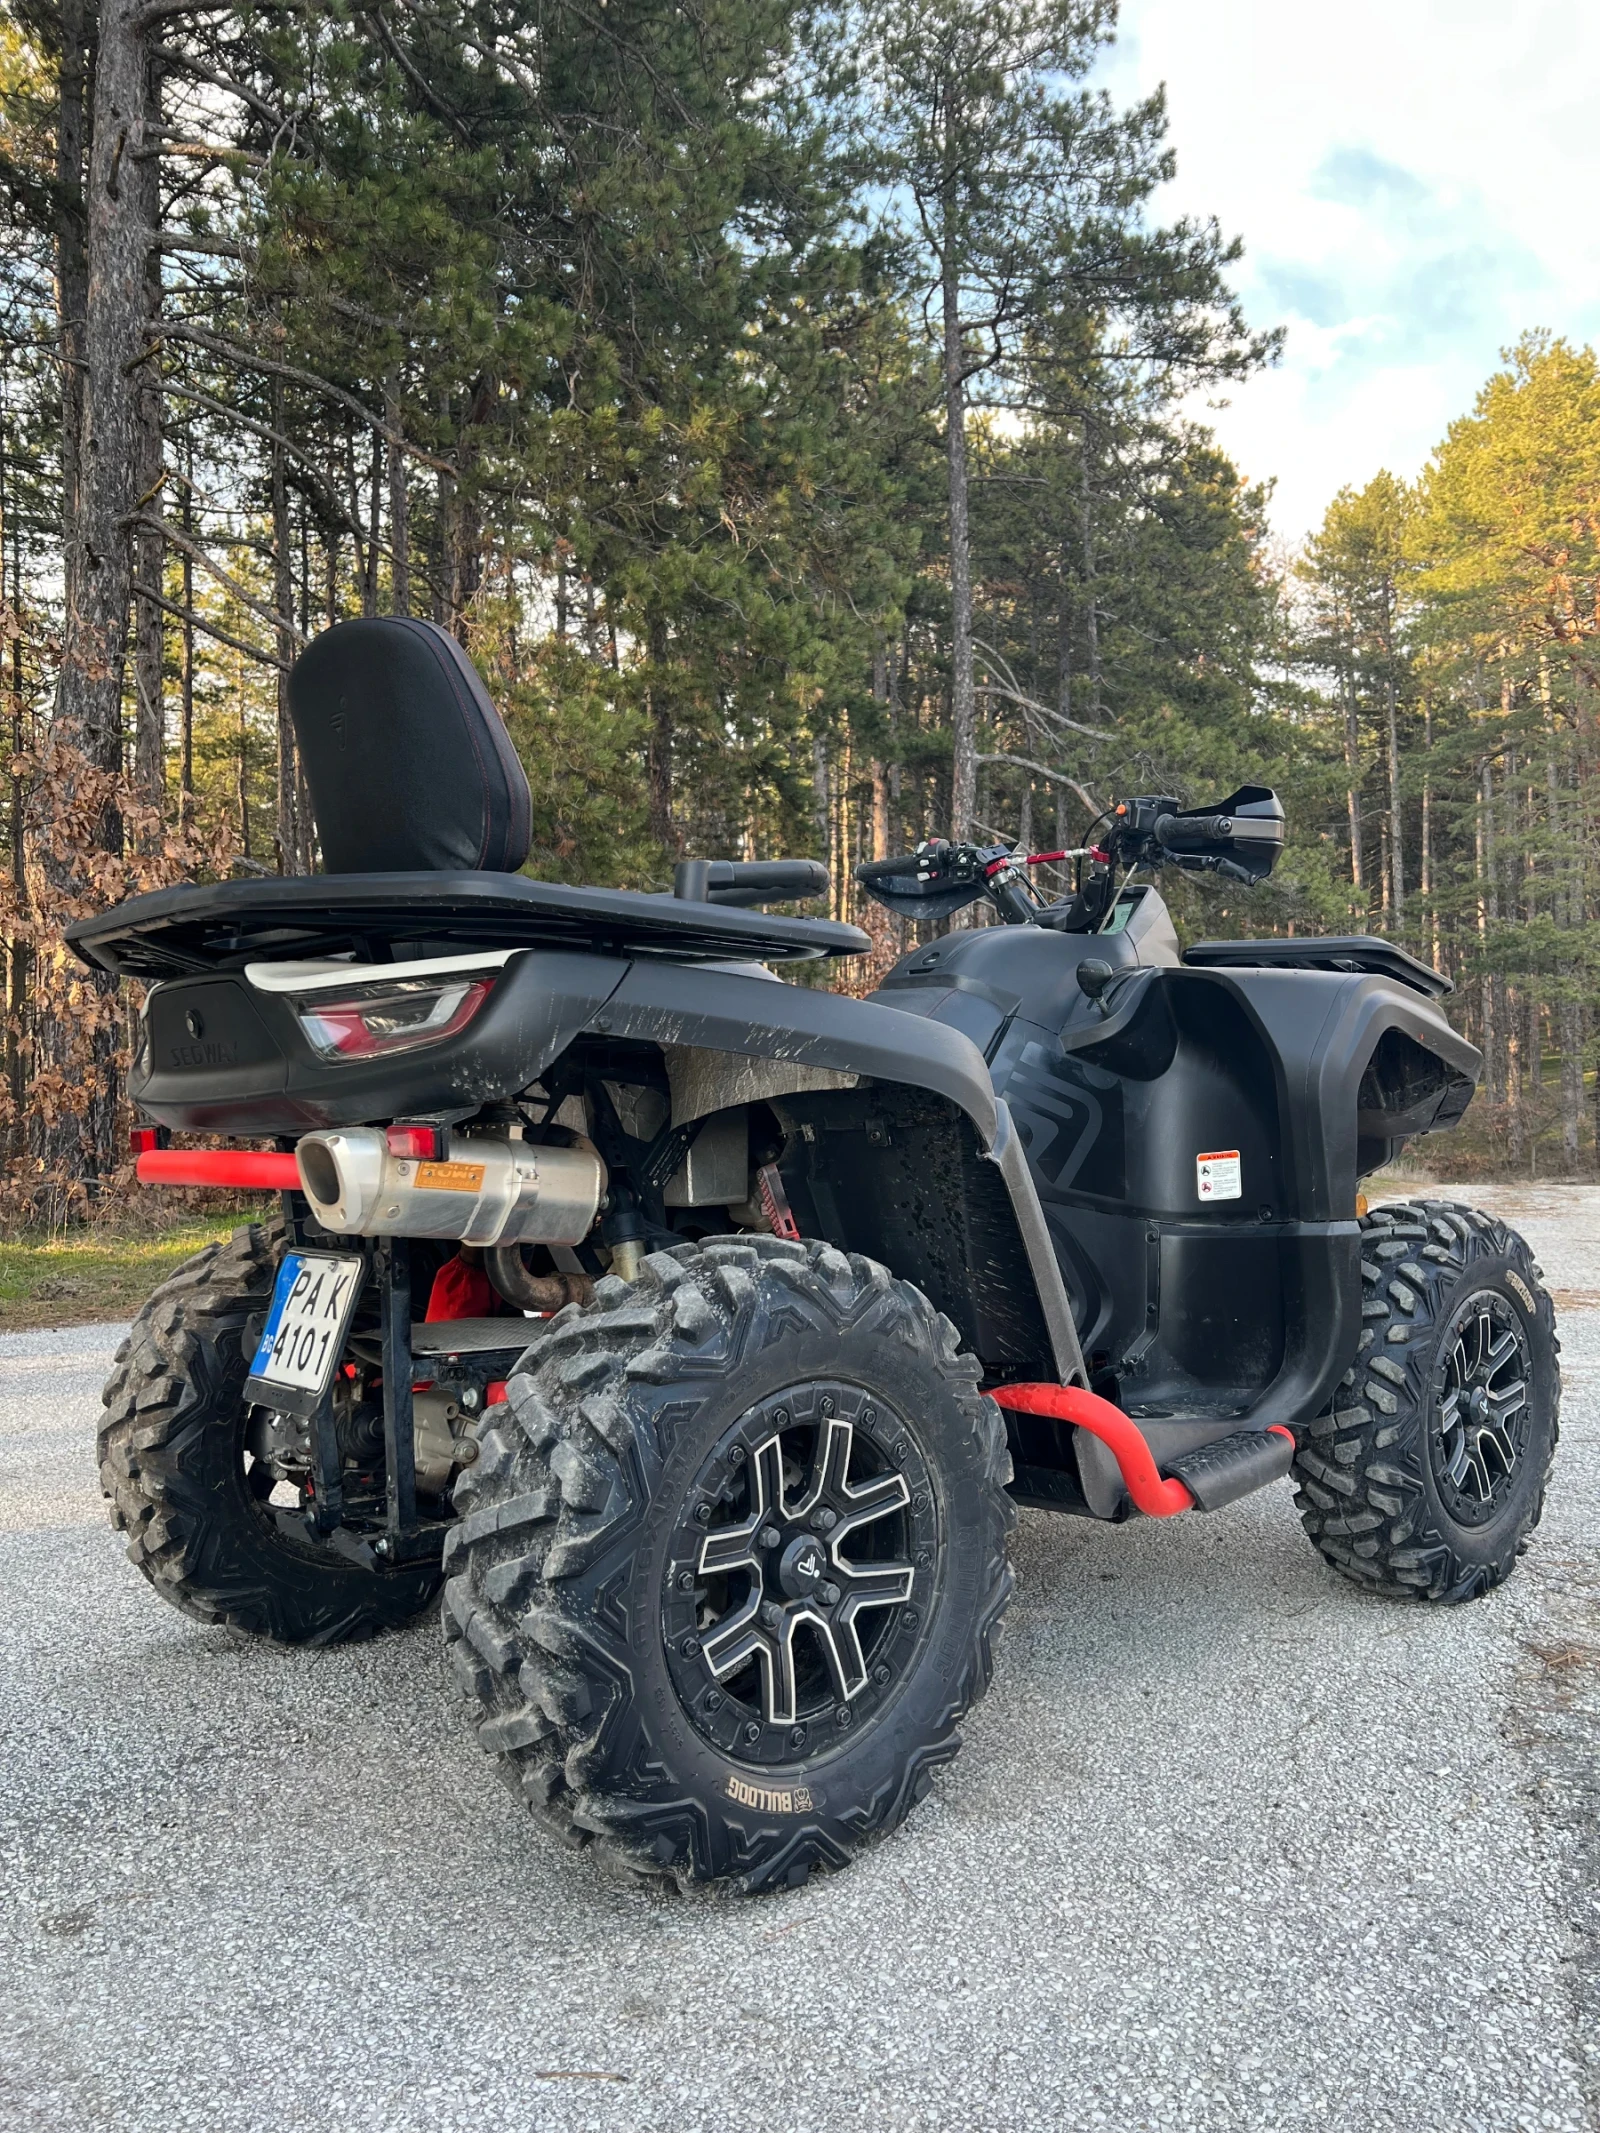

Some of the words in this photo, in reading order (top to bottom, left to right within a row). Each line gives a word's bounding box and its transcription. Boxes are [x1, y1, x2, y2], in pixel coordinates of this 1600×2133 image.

[170, 1041, 238, 1067] SEGWAY
[260, 1334, 274, 1354] BG
[272, 1323, 331, 1375] 4101
[728, 1776, 793, 1812] BULLDOG
